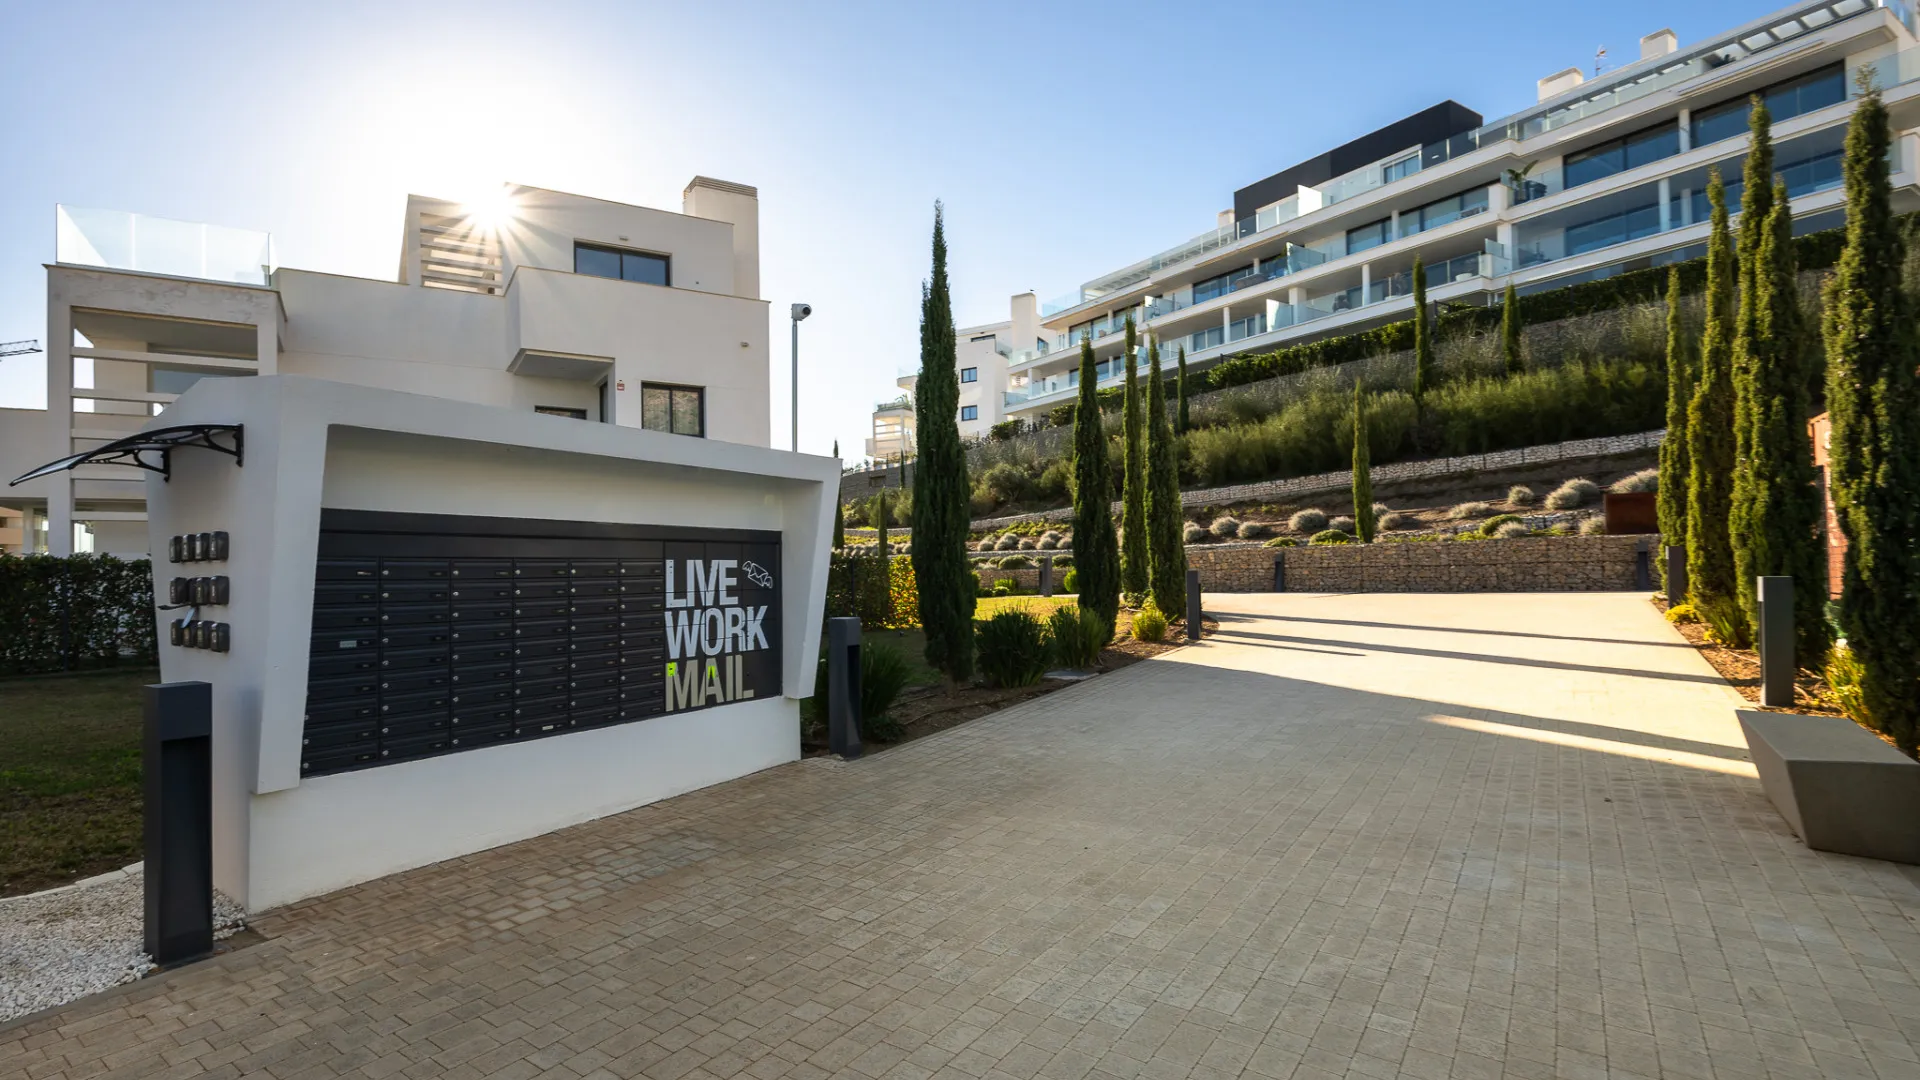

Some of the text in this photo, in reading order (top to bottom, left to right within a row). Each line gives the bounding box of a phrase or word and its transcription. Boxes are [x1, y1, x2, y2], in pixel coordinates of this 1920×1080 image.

[665, 559, 739, 608] LIVE
[664, 605, 769, 659] WORK
[665, 654, 754, 712] MAIL
